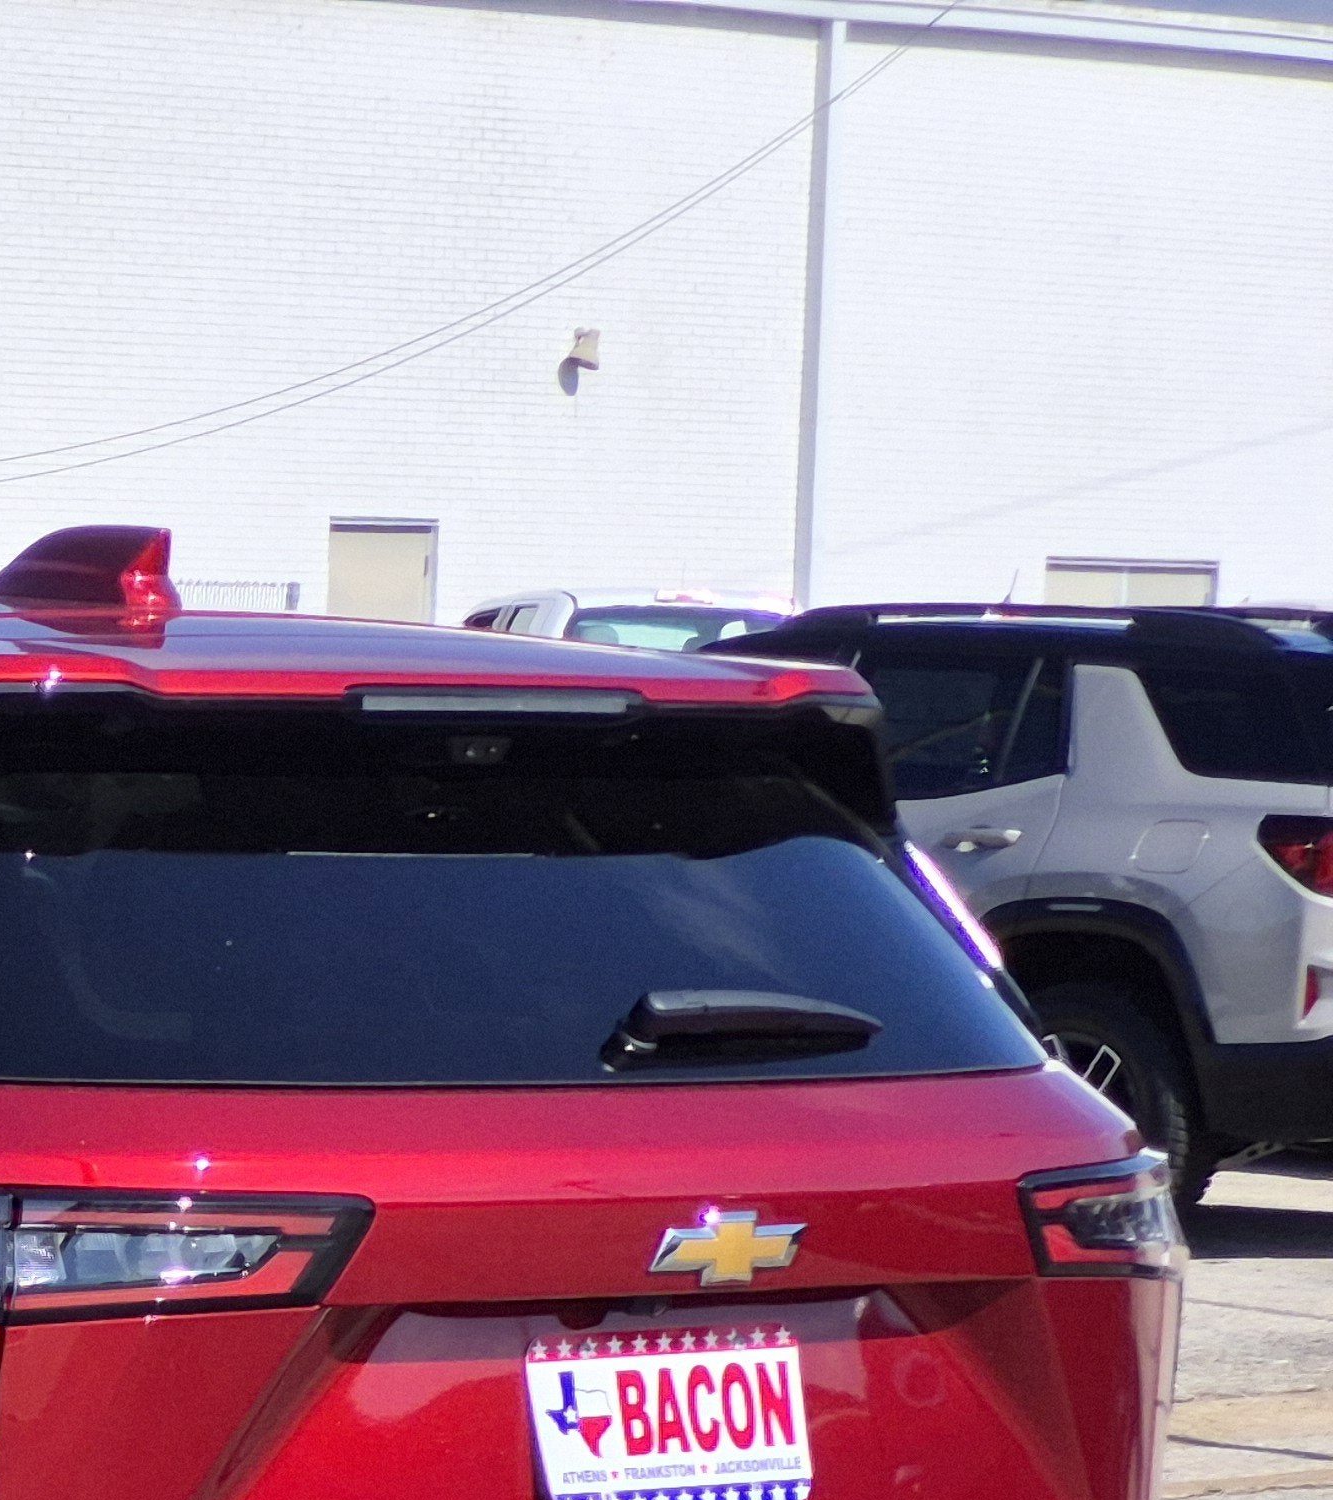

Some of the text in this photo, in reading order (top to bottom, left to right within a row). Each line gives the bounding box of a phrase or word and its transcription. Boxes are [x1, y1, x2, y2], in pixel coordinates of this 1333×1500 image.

[616, 1361, 797, 1457] BACON
[562, 1456, 802, 1484] ATHENS FRANKSTON JACKSONVILLE
